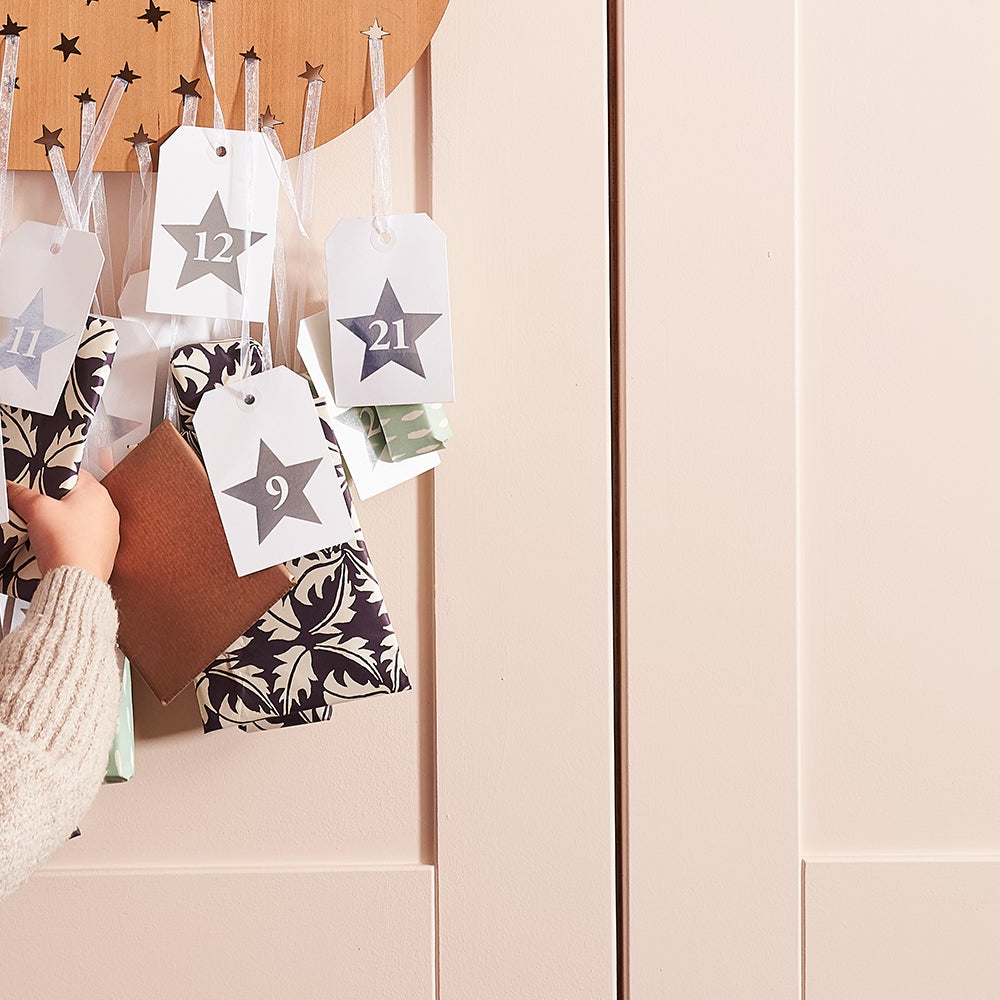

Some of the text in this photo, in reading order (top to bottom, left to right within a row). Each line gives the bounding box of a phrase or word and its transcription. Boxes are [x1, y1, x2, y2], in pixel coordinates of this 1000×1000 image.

[192, 229, 234, 264] 12
[7, 326, 41, 358] 11
[368, 318, 407, 349] 21
[265, 475, 290, 512] 9
